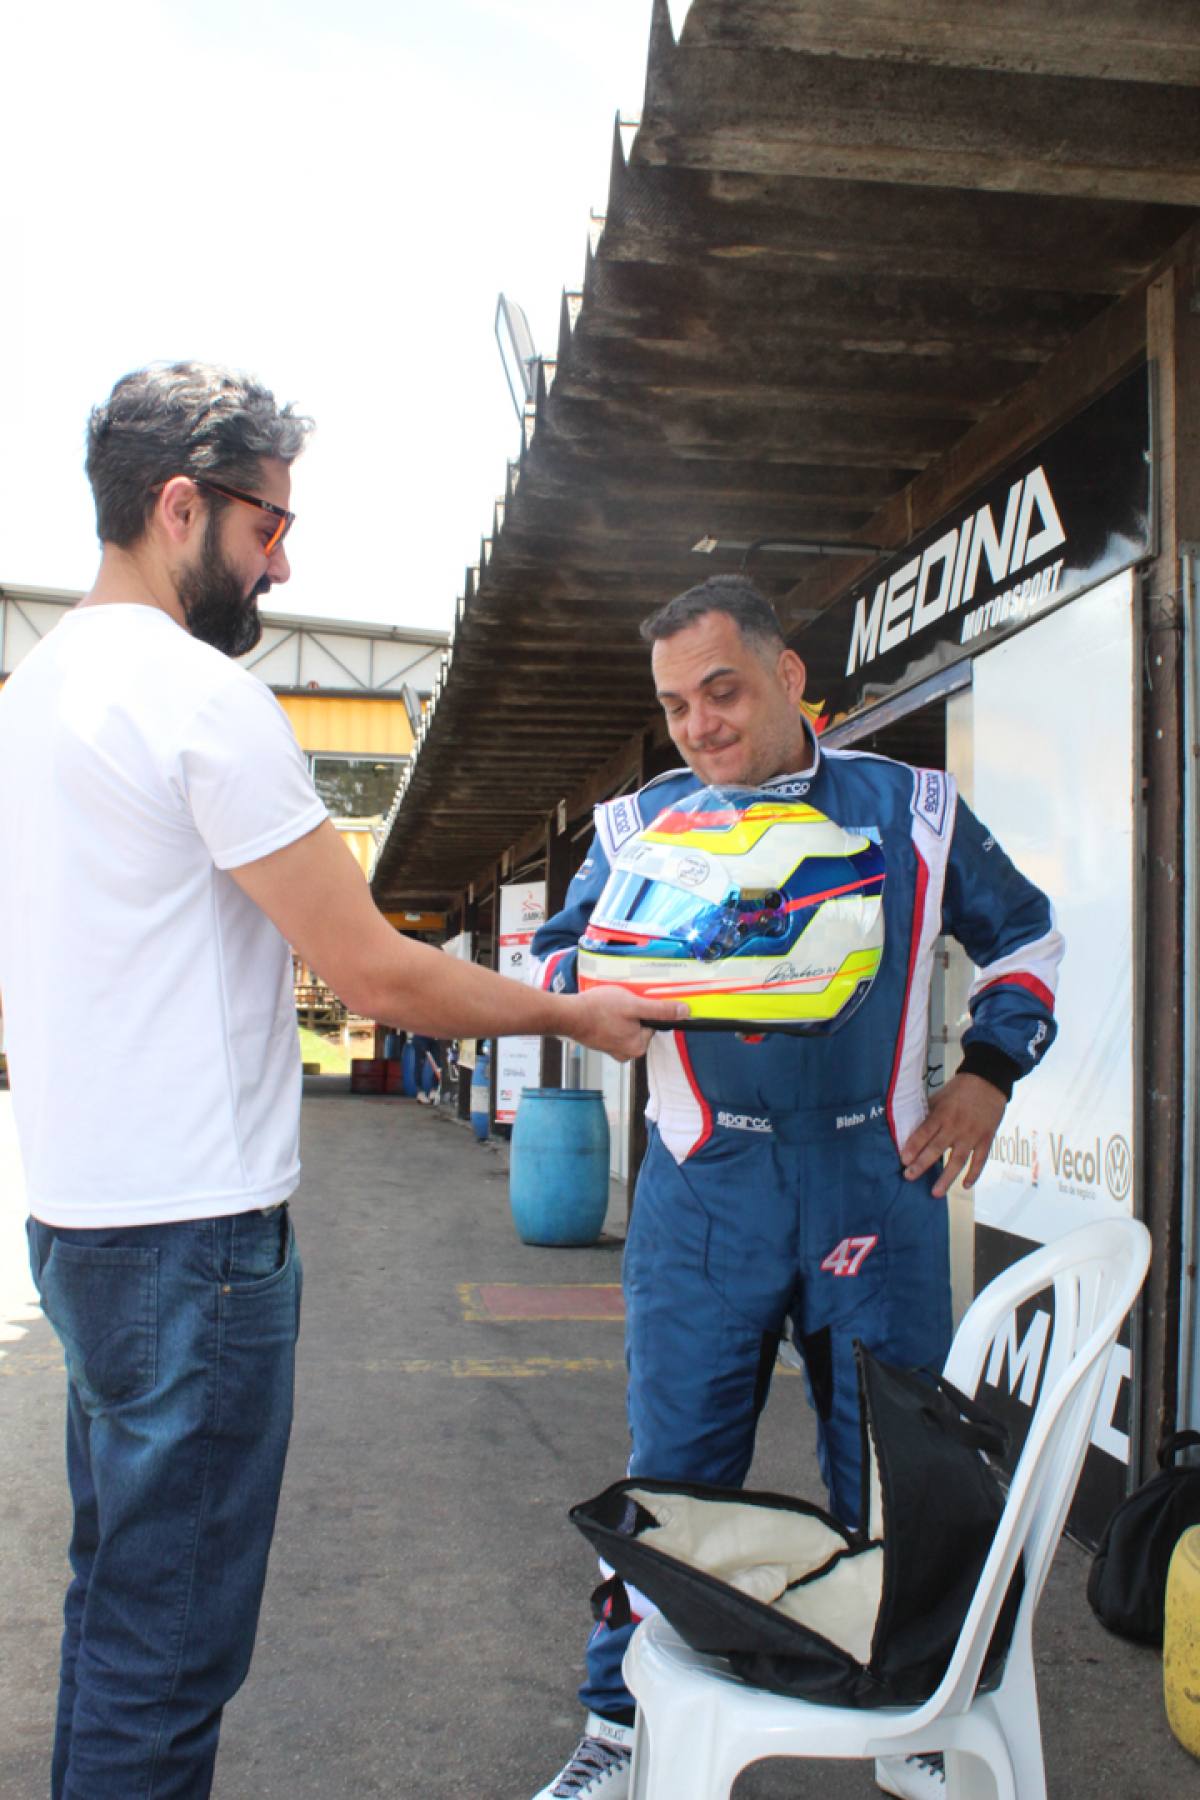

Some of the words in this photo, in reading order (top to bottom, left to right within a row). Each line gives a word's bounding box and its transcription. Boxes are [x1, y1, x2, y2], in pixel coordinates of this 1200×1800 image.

[845, 465, 1066, 677] MEDINA
[960, 558, 1064, 645] MOTORSPORT
[717, 1111, 774, 1132] sparco
[1049, 1132, 1101, 1185] Vecol
[820, 1235, 878, 1276] 47
